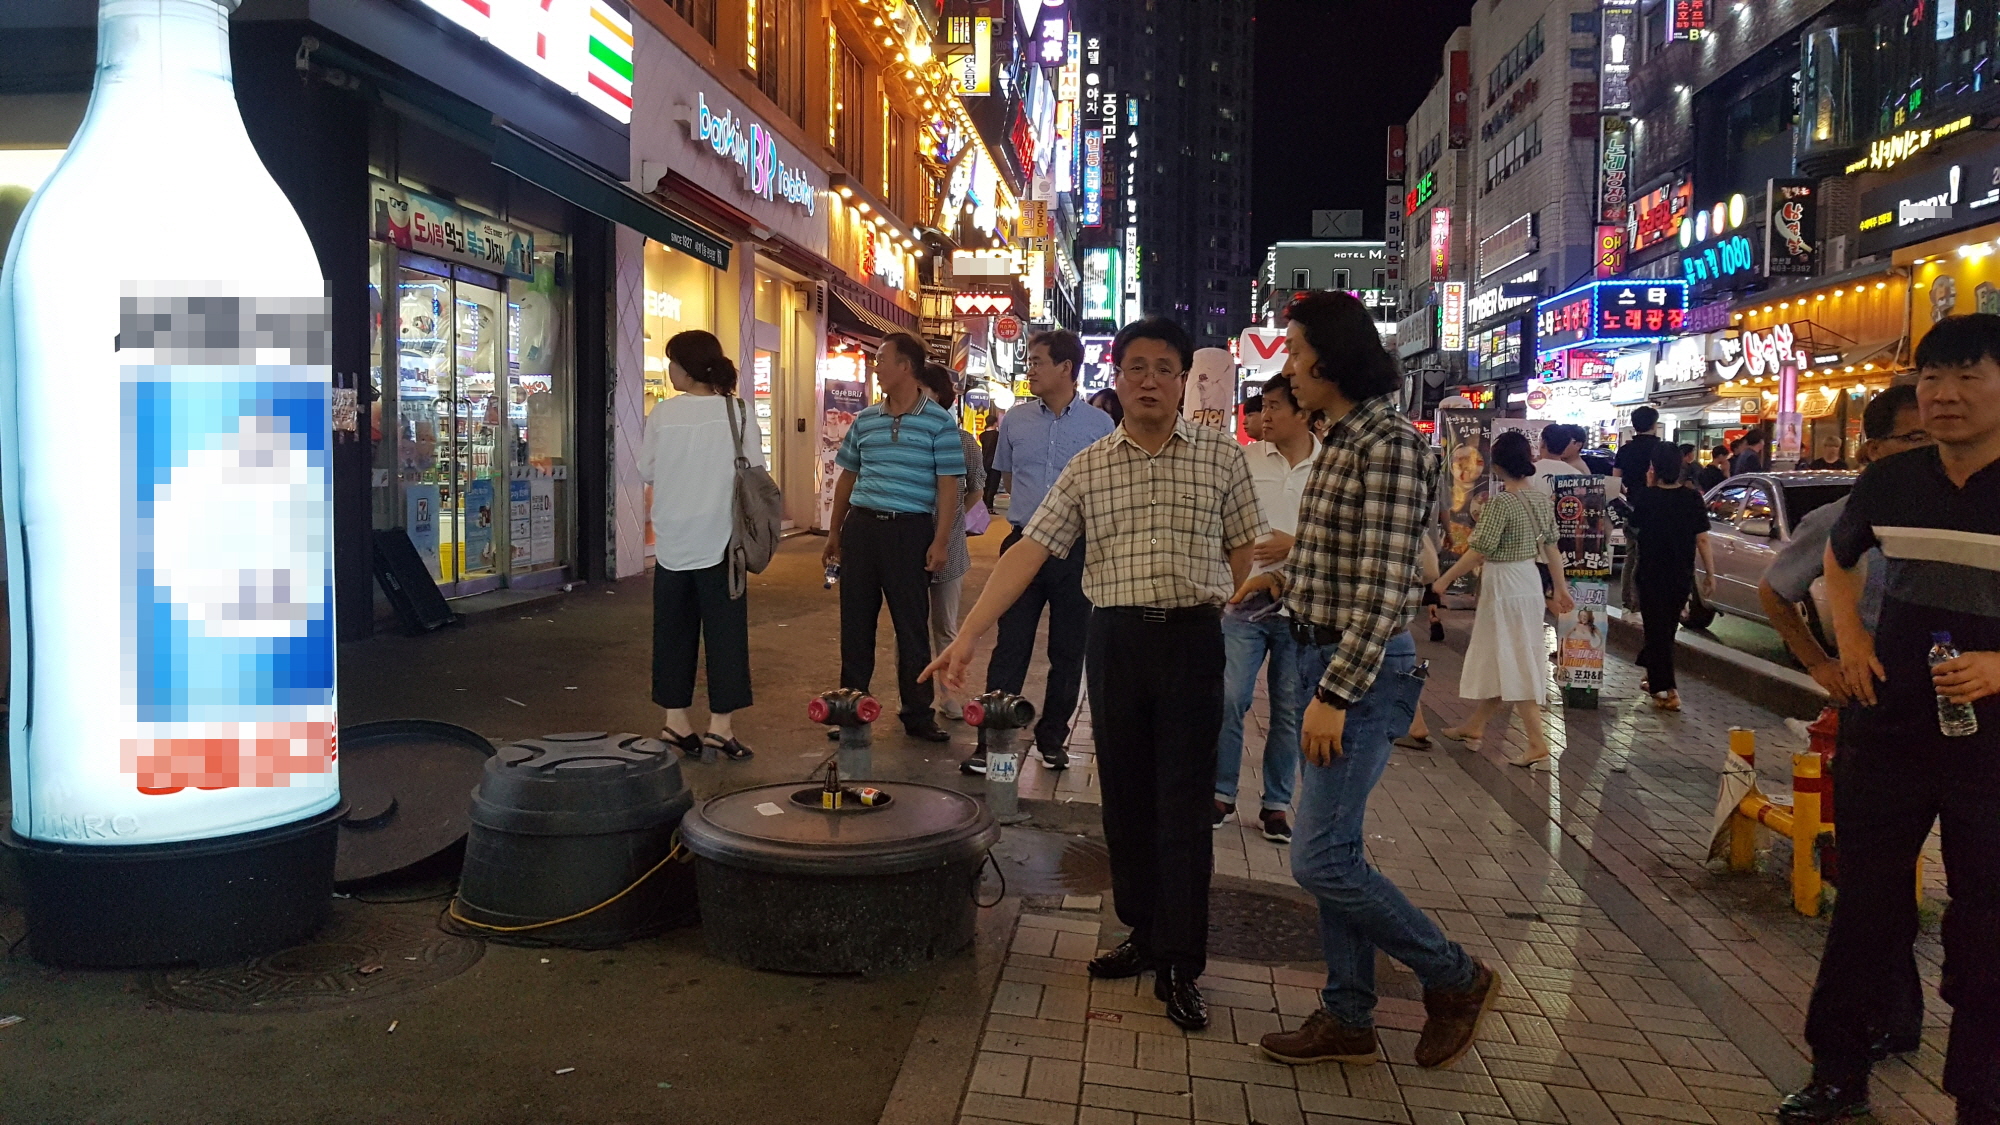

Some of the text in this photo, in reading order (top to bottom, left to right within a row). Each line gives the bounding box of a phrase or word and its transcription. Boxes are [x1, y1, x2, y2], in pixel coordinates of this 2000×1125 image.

[1086, 37, 1100, 115] 호텔 야자
[1102, 93, 1117, 145] HOTEL
[751, 122, 774, 202] BR
[1606, 138, 1627, 204] 노래광장
[414, 212, 445, 248] 도시락
[444, 222, 465, 253] 먹고
[671, 232, 682, 245] SINCE
[1602, 236, 1617, 275] 애인
[1717, 235, 1752, 275] 7080
[1618, 287, 1667, 306] 스타
[1537, 298, 1590, 337] 스타 노래광장
[1603, 308, 1685, 331] 노래광장
[1557, 479, 1579, 488] BACK
